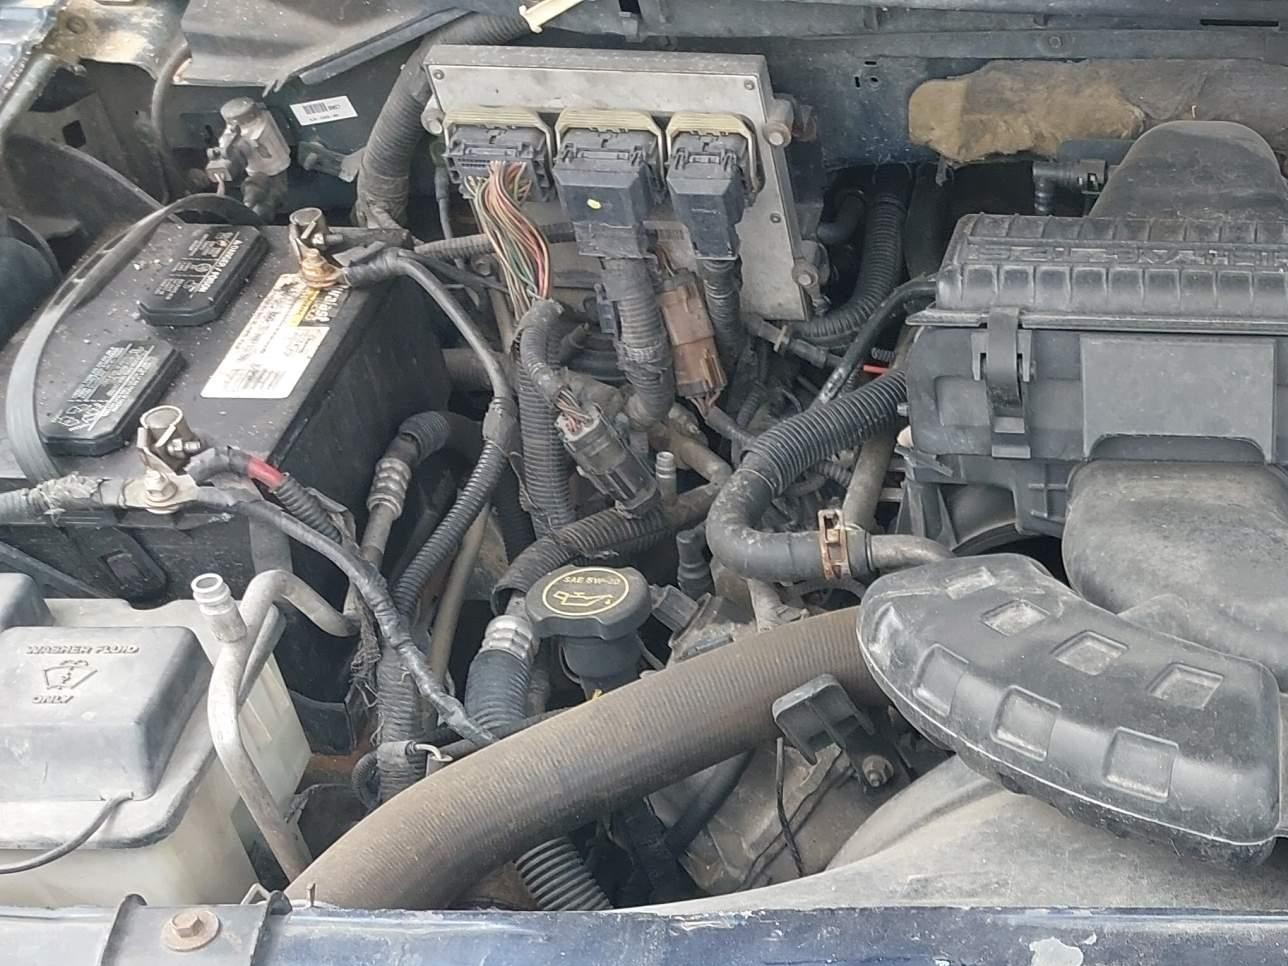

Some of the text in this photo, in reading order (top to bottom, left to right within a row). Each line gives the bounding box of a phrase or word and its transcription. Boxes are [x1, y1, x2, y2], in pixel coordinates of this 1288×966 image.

[562, 576, 585, 584] SAE
[26, 644, 140, 654] WASHER FLUID
[32, 694, 75, 704] ONLY
